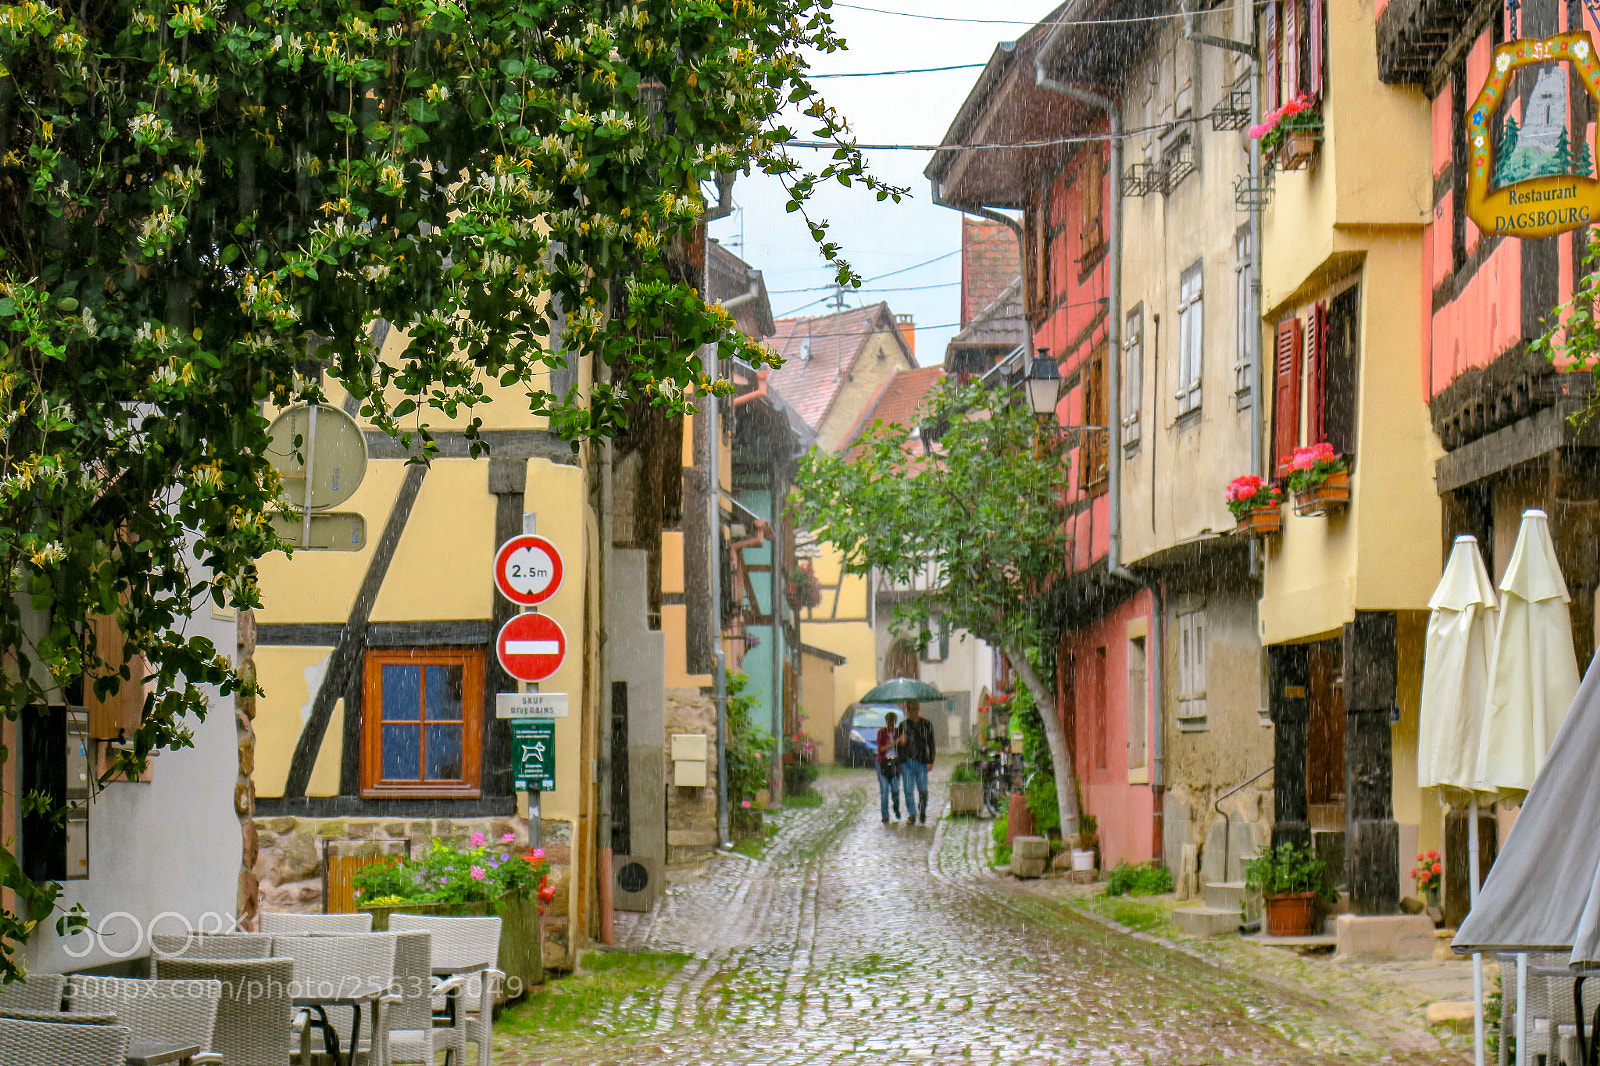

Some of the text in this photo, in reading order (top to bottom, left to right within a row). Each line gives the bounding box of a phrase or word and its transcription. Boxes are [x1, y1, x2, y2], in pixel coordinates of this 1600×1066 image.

[1509, 184, 1577, 205] Restaurant
[1495, 206, 1590, 232] DAGSBOURG
[522, 697, 543, 705] SAUF
